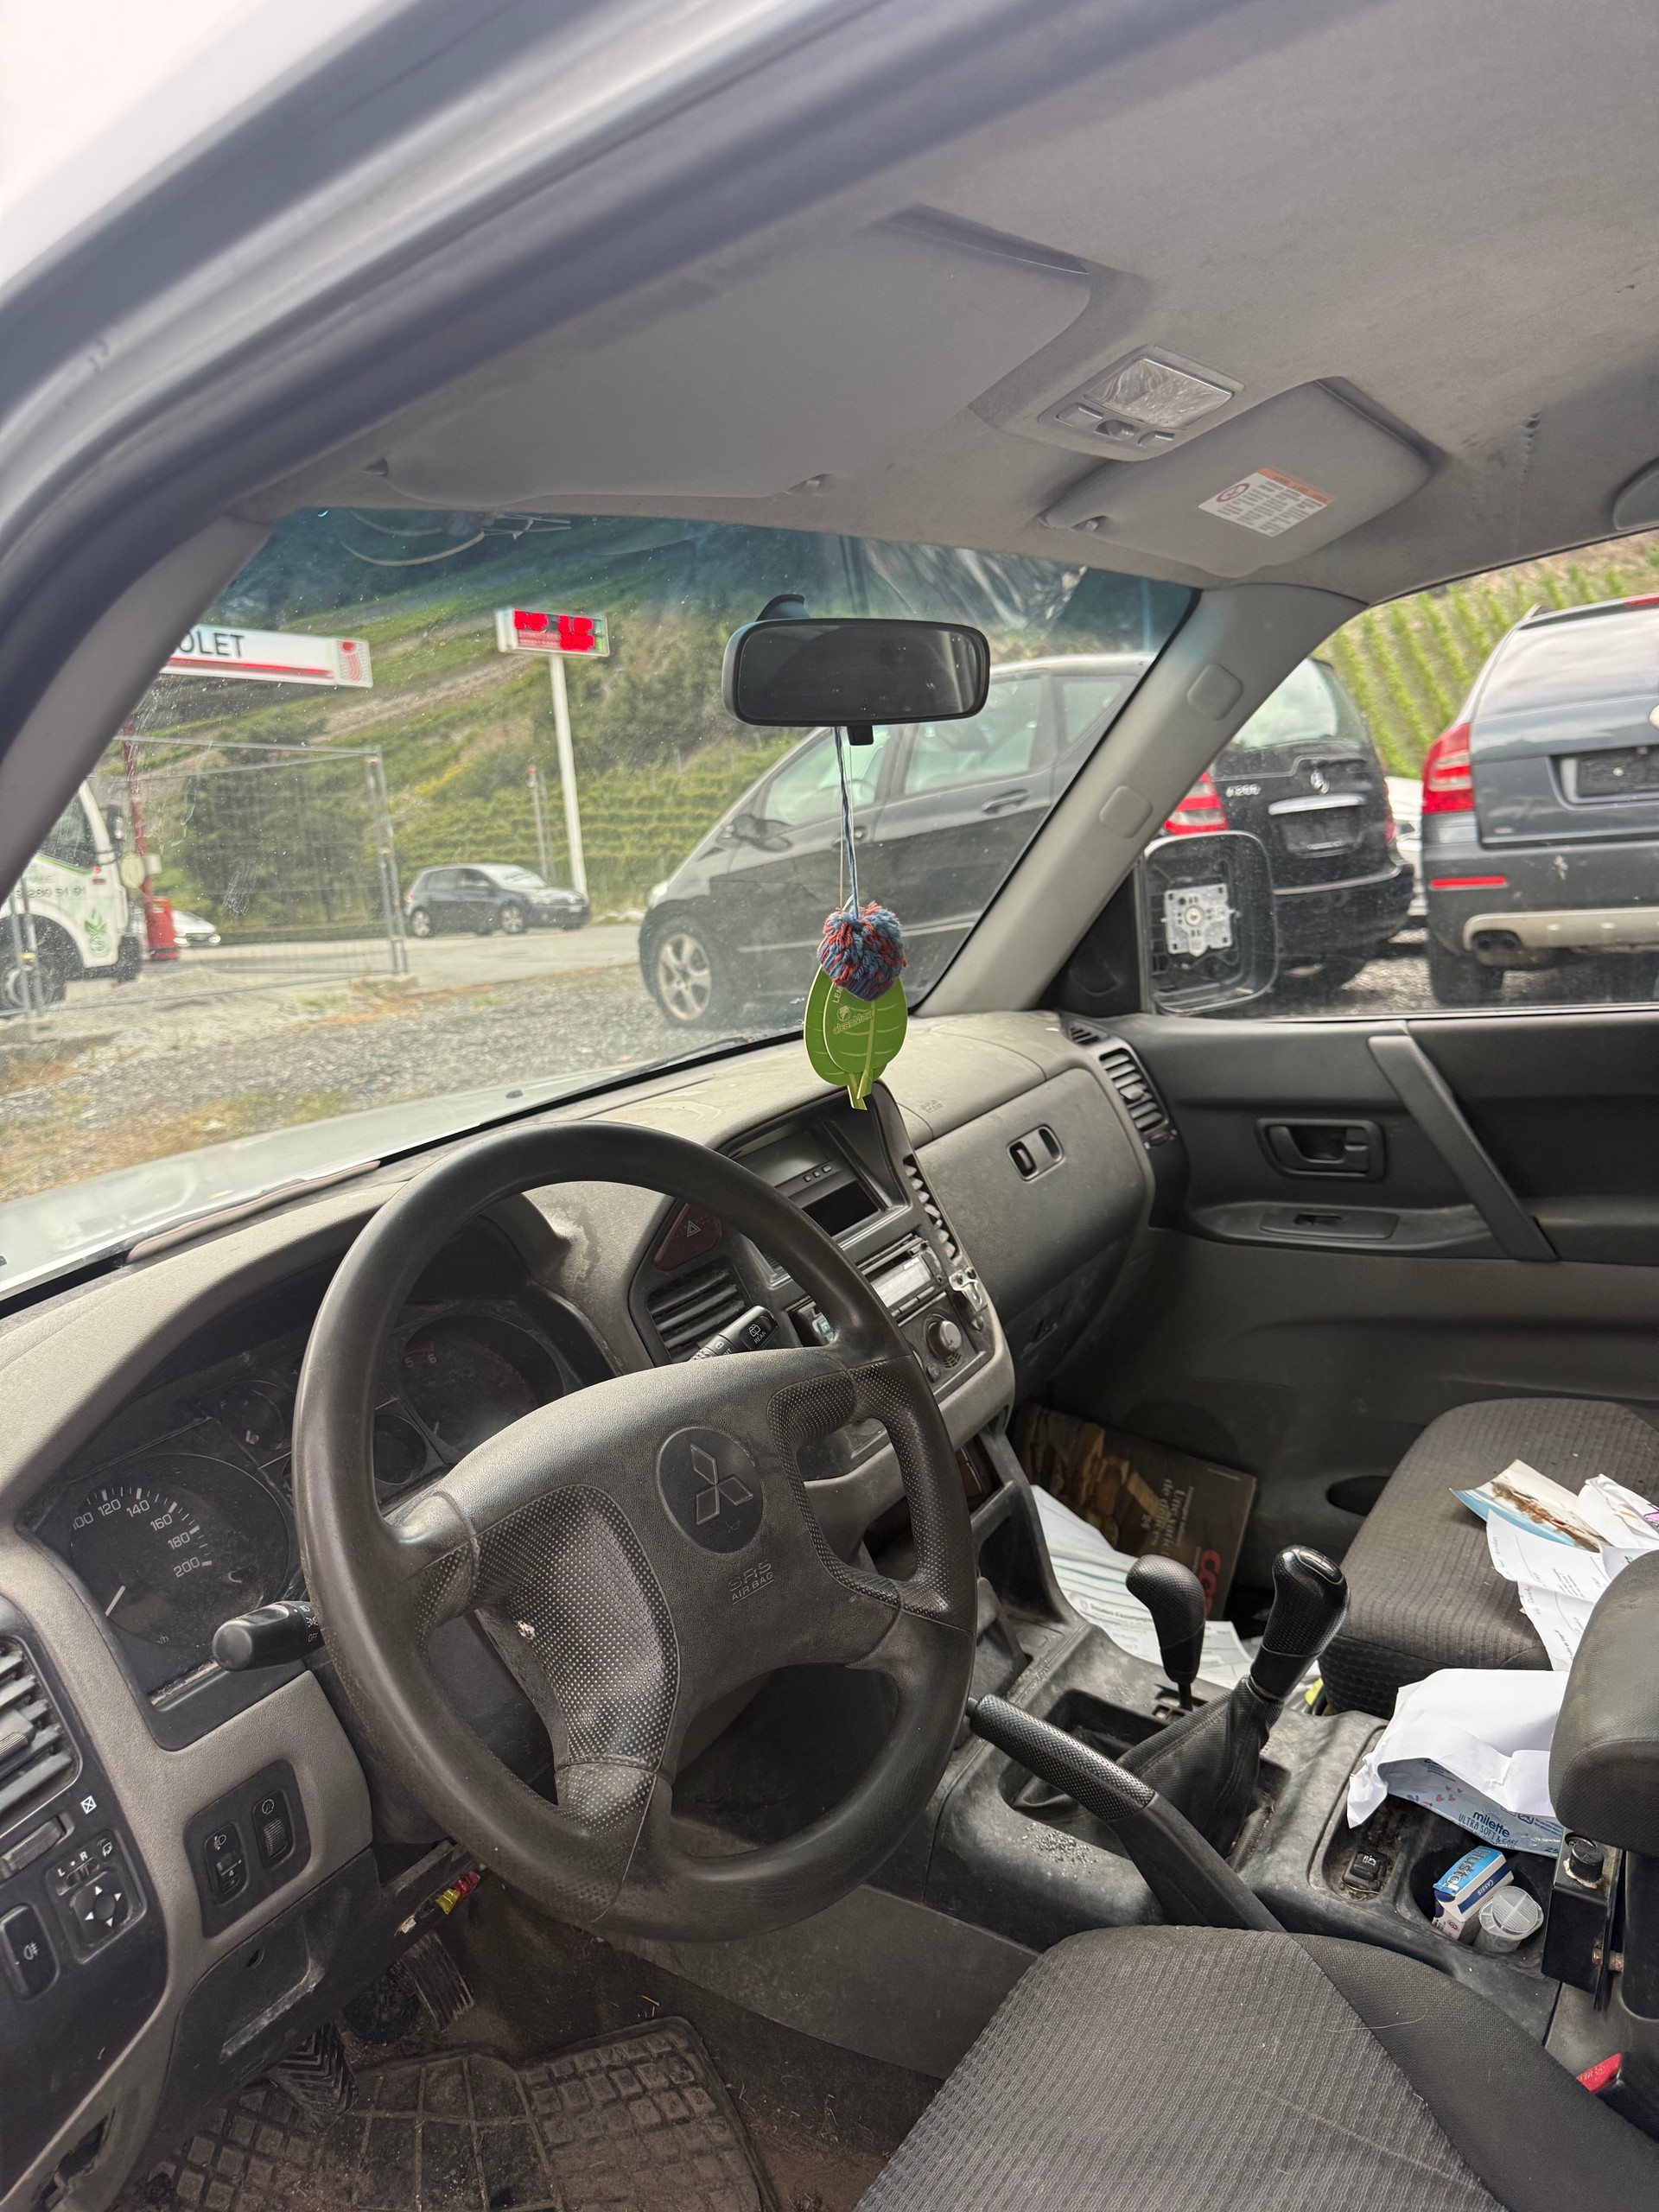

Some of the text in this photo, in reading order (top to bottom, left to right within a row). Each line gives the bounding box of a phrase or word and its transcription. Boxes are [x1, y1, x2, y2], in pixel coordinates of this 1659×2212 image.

[832, 985, 844, 1004] LEM
[753, 1331, 767, 1344] REAR
[404, 1353, 437, 1368] 5 6
[98, 1498, 122, 1516] 120
[126, 1499, 150, 1517] 140
[149, 1513, 173, 1531] 160
[167, 1532, 191, 1549] 180
[174, 1556, 200, 1578] 200
[732, 1571, 773, 1601] AIR BAG
[1458, 1813, 1479, 1832] ULTRA
[1480, 1823, 1496, 1840] SOFT
[1471, 1811, 1510, 1838] milette
[57, 1851, 88, 1878] L R
